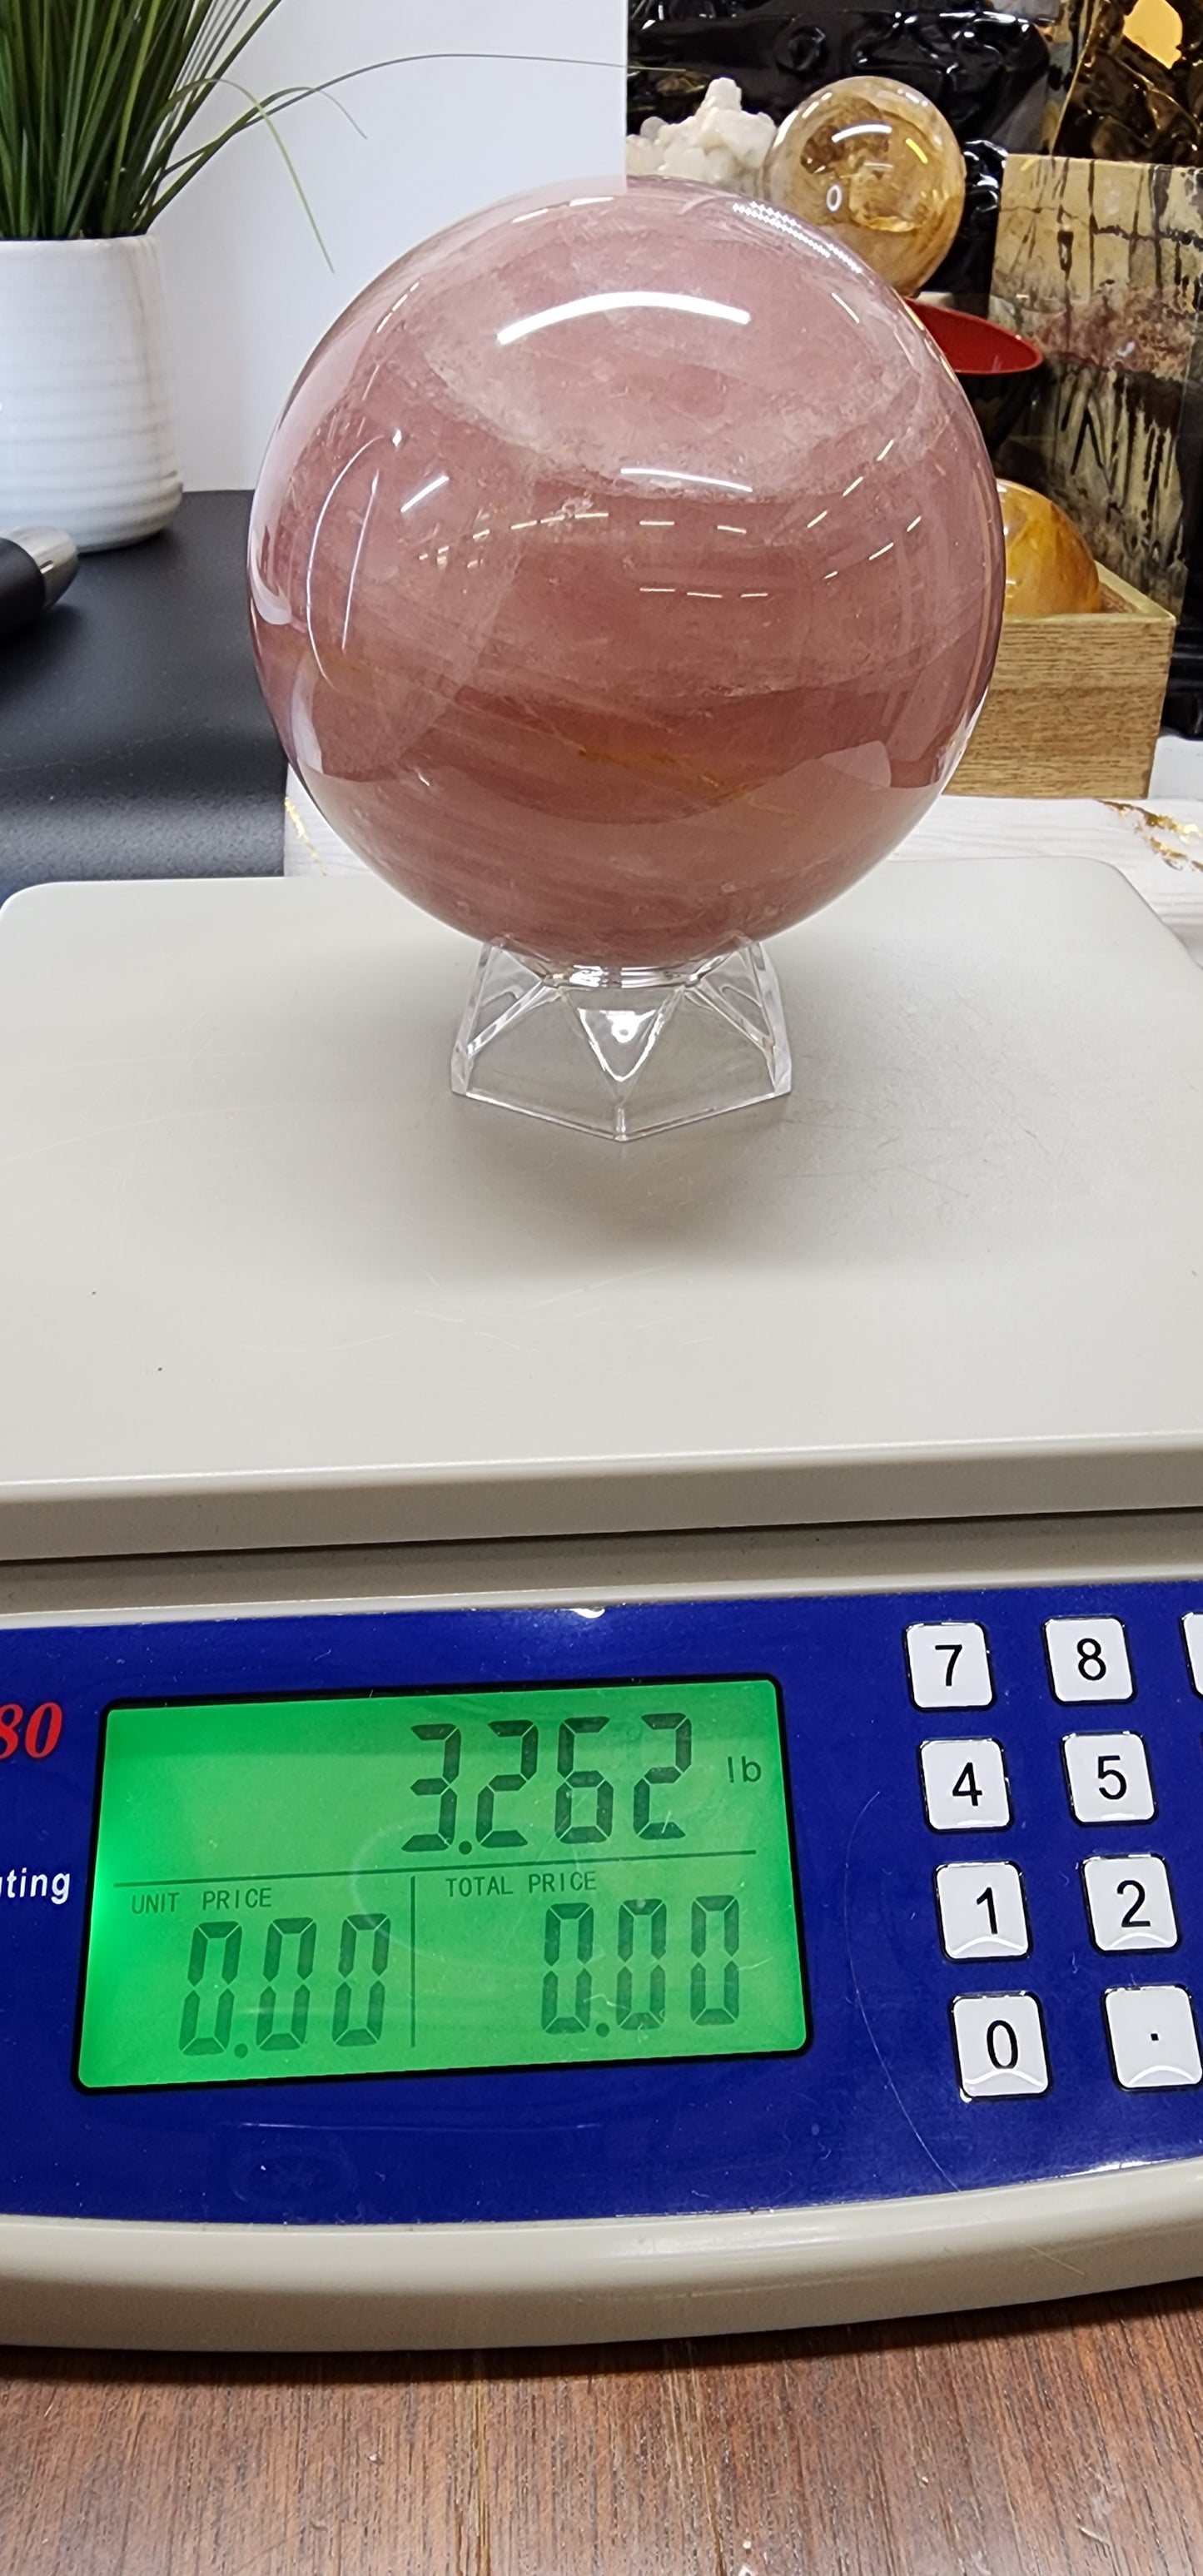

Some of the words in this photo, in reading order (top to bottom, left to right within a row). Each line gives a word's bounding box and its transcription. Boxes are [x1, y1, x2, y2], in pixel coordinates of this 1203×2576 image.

[935, 1644, 963, 1687] 7
[1076, 1638, 1107, 1681] 8
[0, 1702, 62, 1759] 80
[401, 1712, 692, 1856] 3.262
[952, 1762, 982, 1807] 4
[1097, 1755, 1127, 1800] 5
[0, 1867, 70, 1904] ting
[131, 1892, 178, 1913] UNIT
[201, 1887, 273, 1911] PRICE
[445, 1876, 514, 1897] TOTAL
[528, 1871, 597, 1893] PRICE
[1116, 1879, 1151, 1928] 2
[976, 1887, 999, 1935] 1
[178, 1913, 391, 2059] 0.00
[540, 1895, 740, 2037] 0.00
[986, 2020, 1020, 2070] 0
